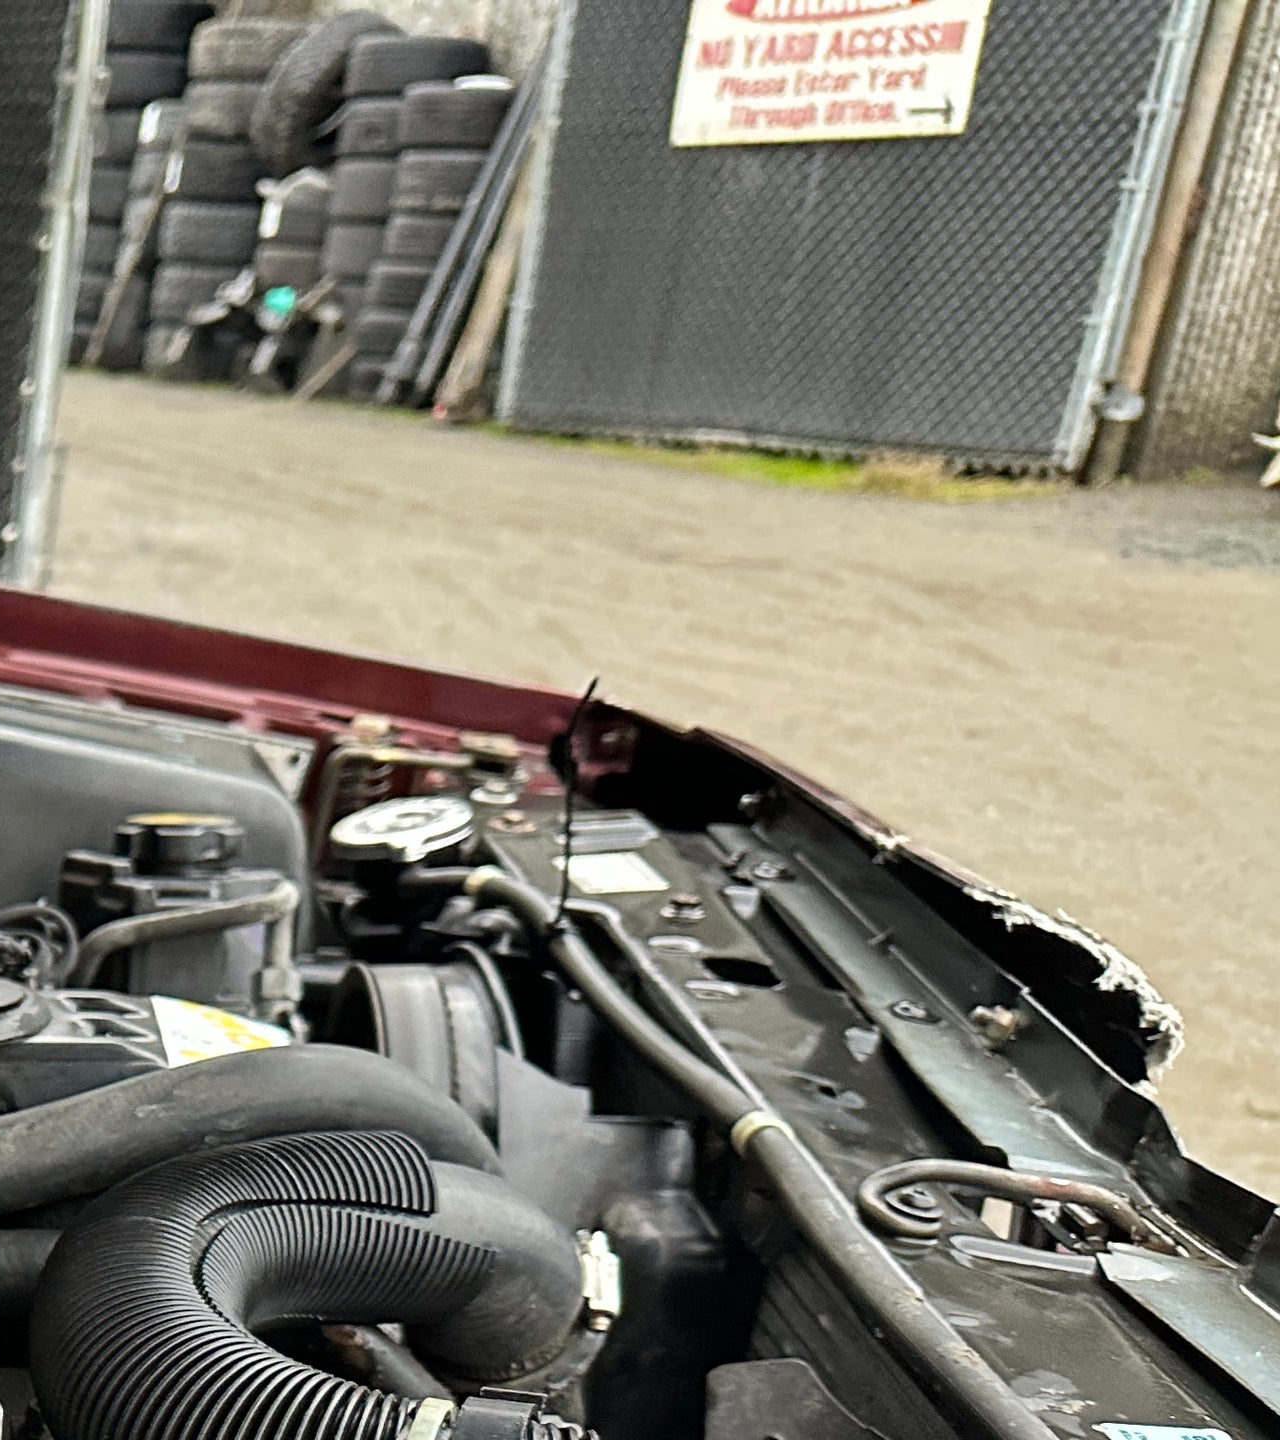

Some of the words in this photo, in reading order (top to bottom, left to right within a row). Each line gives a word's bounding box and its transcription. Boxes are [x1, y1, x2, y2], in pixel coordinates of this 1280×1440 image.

[697, 37, 733, 69] NO
[743, 32, 818, 67] YARD
[794, 68, 859, 95] Enter
[868, 63, 928, 92] Yard
